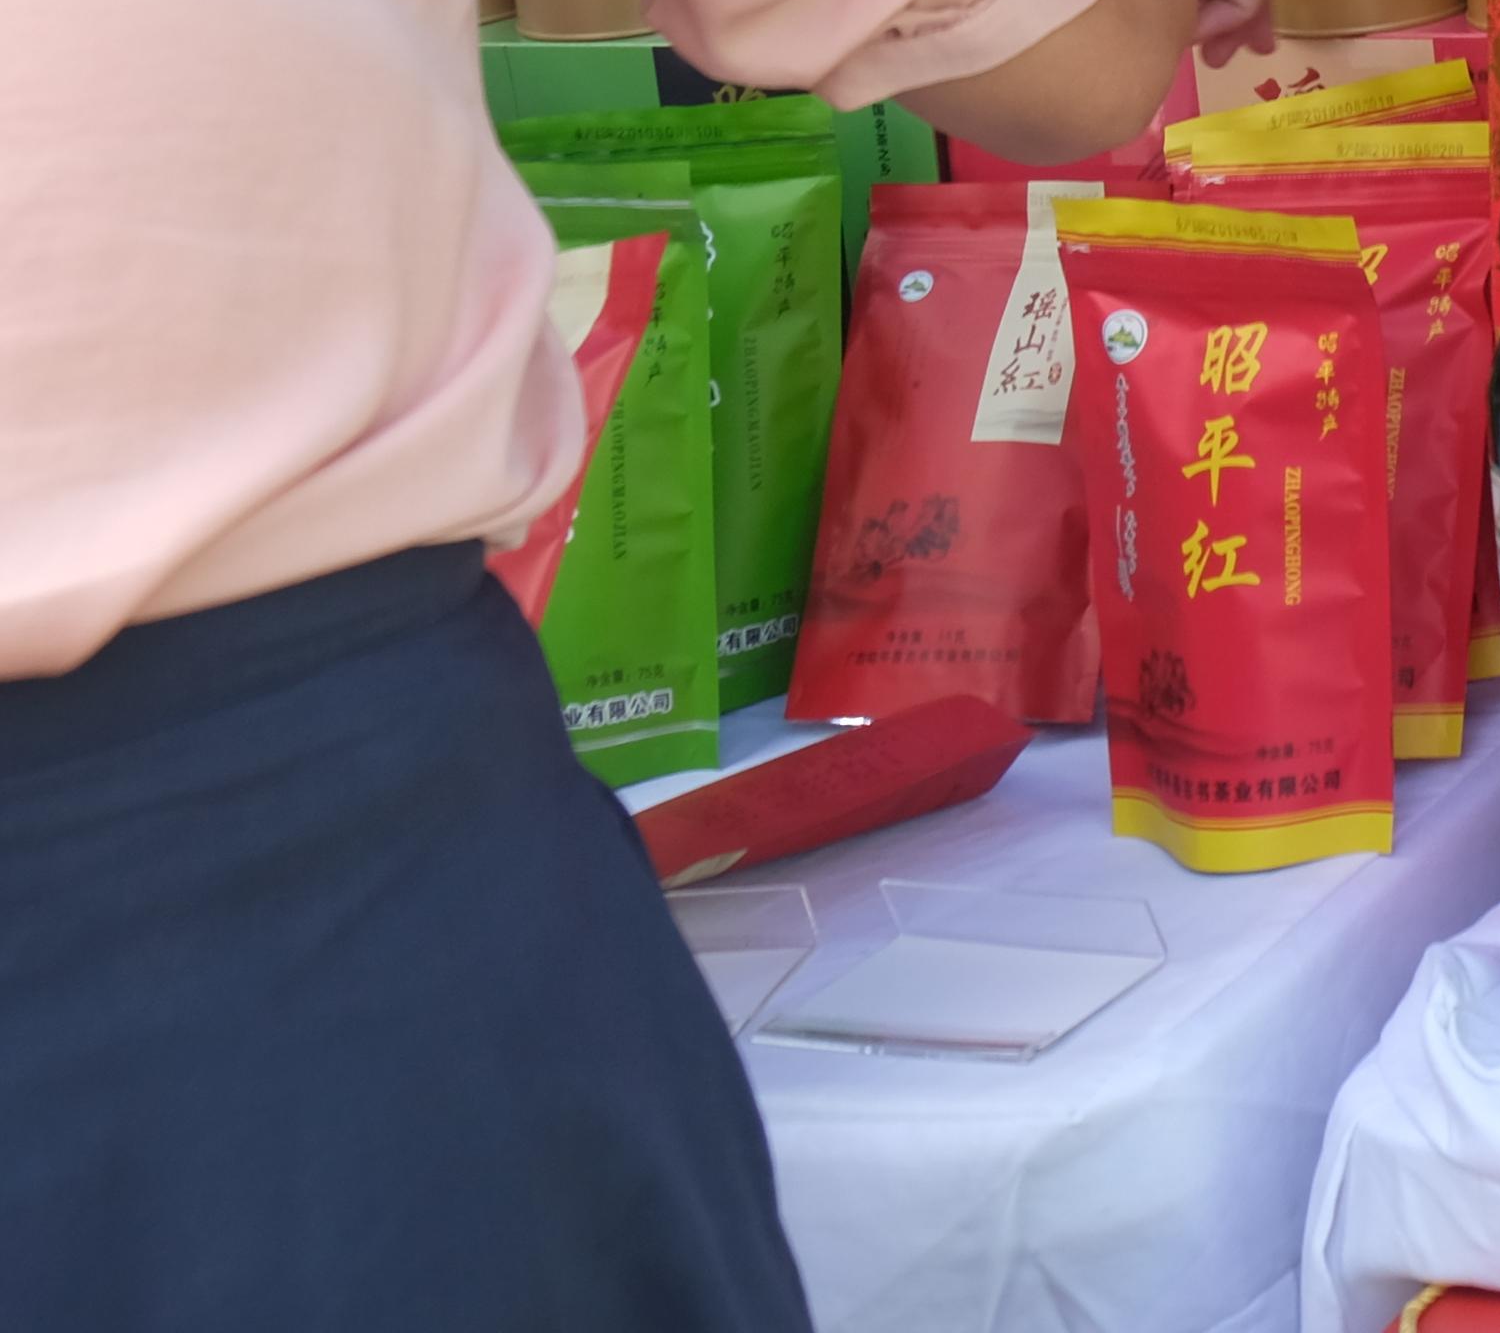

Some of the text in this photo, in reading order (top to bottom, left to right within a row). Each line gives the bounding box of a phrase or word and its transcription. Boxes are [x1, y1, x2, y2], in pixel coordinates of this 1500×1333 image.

[1181, 321, 1269, 599] 昭平红
[1284, 465, 1302, 606] ZHAOPINGHONG
